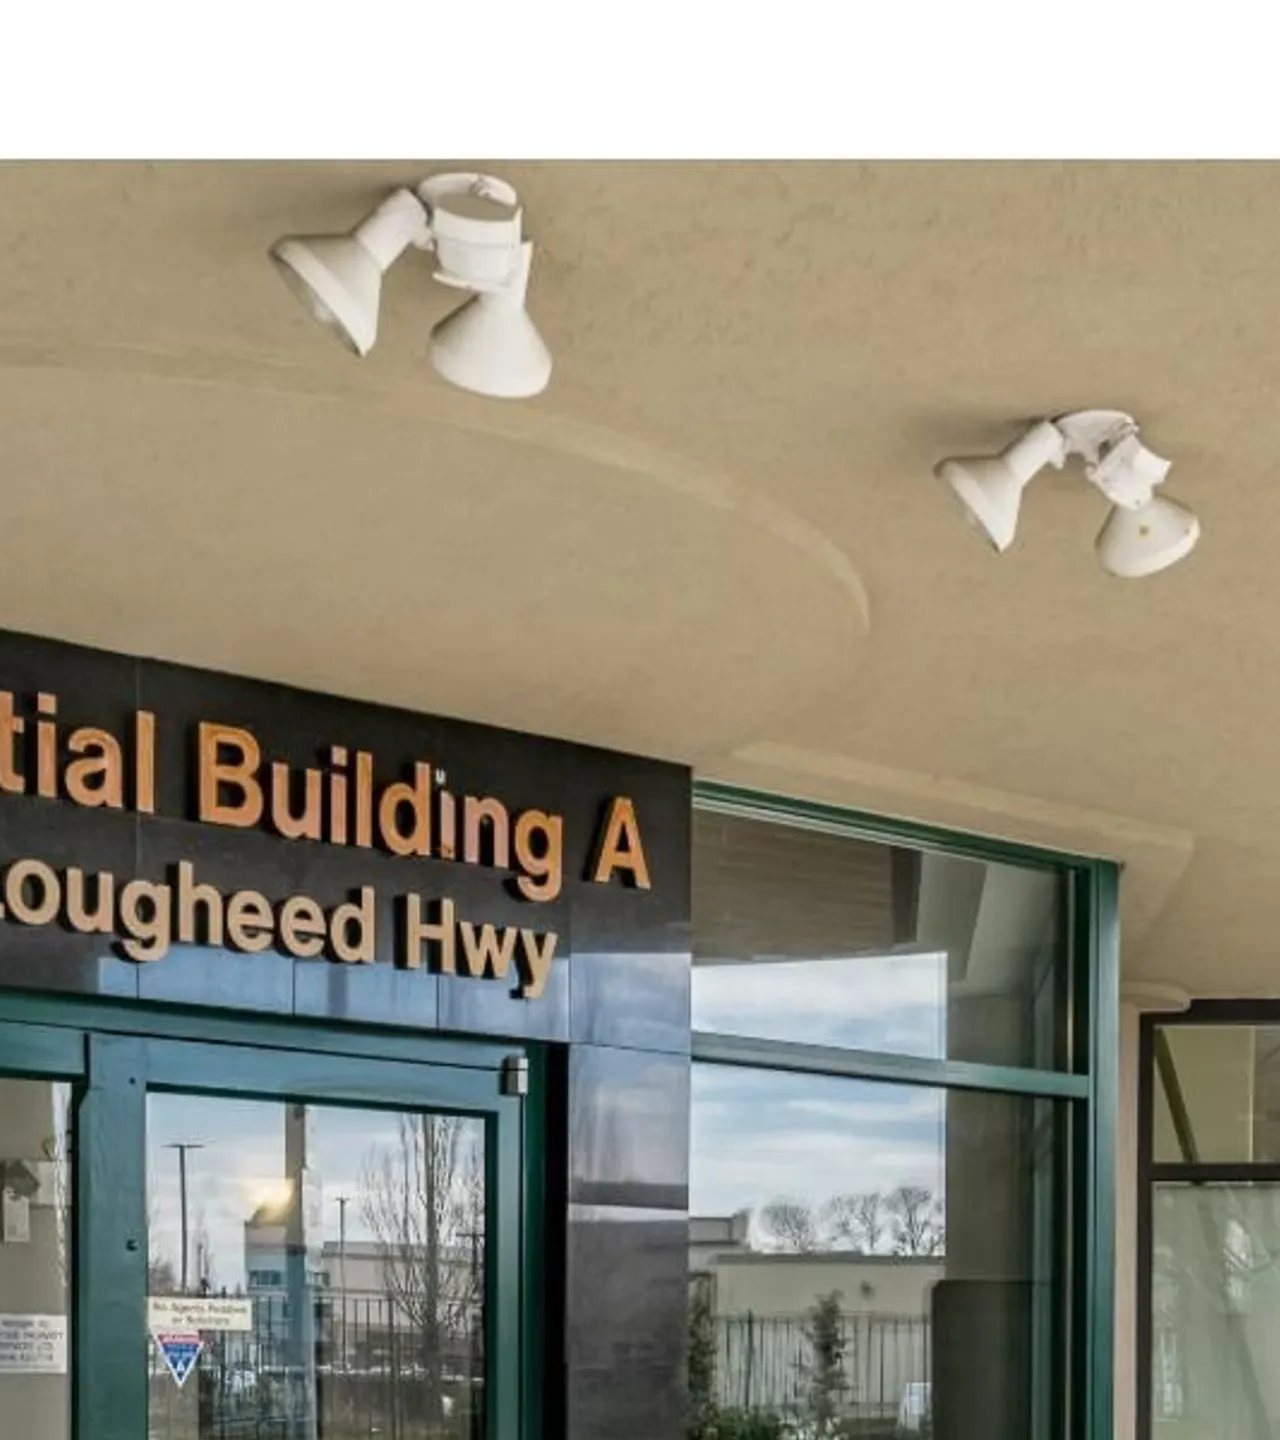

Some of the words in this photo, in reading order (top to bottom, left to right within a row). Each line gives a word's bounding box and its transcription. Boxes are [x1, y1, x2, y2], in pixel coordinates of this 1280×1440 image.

[199, 721, 564, 903] Building
[594, 796, 652, 890] A
[405, 892, 558, 999] Hwy
